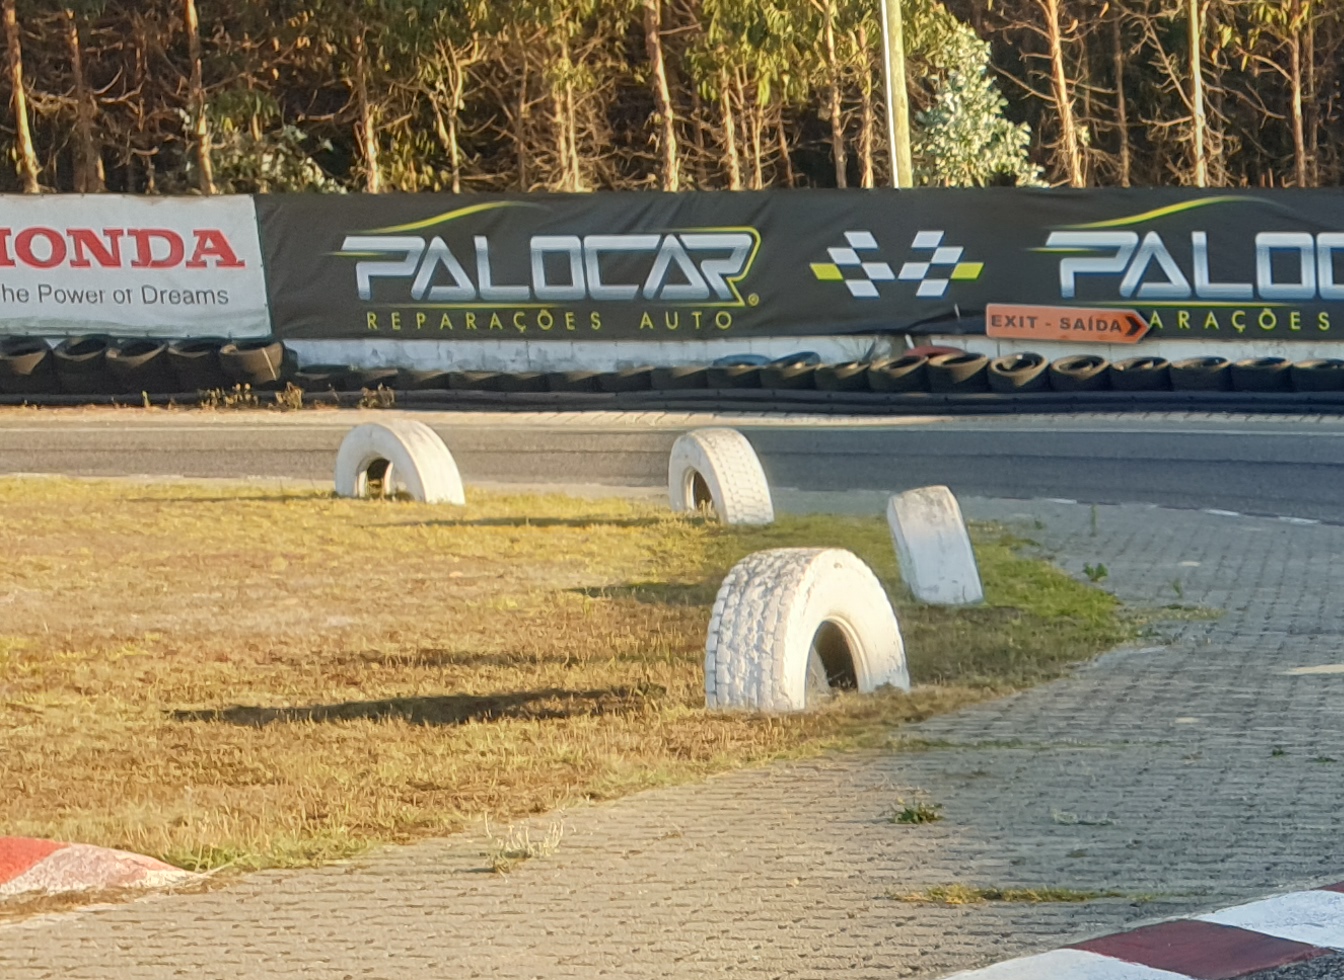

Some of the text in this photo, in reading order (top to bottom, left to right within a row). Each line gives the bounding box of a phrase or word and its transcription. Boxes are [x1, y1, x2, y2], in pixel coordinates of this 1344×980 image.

[341, 234, 754, 300] PALOCAR
[0, 283, 29, 303] he
[38, 283, 105, 304] Power
[141, 284, 230, 305] Dreams
[367, 308, 733, 333] REPARAÇÕES AUTO
[990, 314, 1039, 329] EXIT
[1059, 314, 1122, 333] SAÍDA
[1149, 307, 1331, 333] ARAÇÕES
